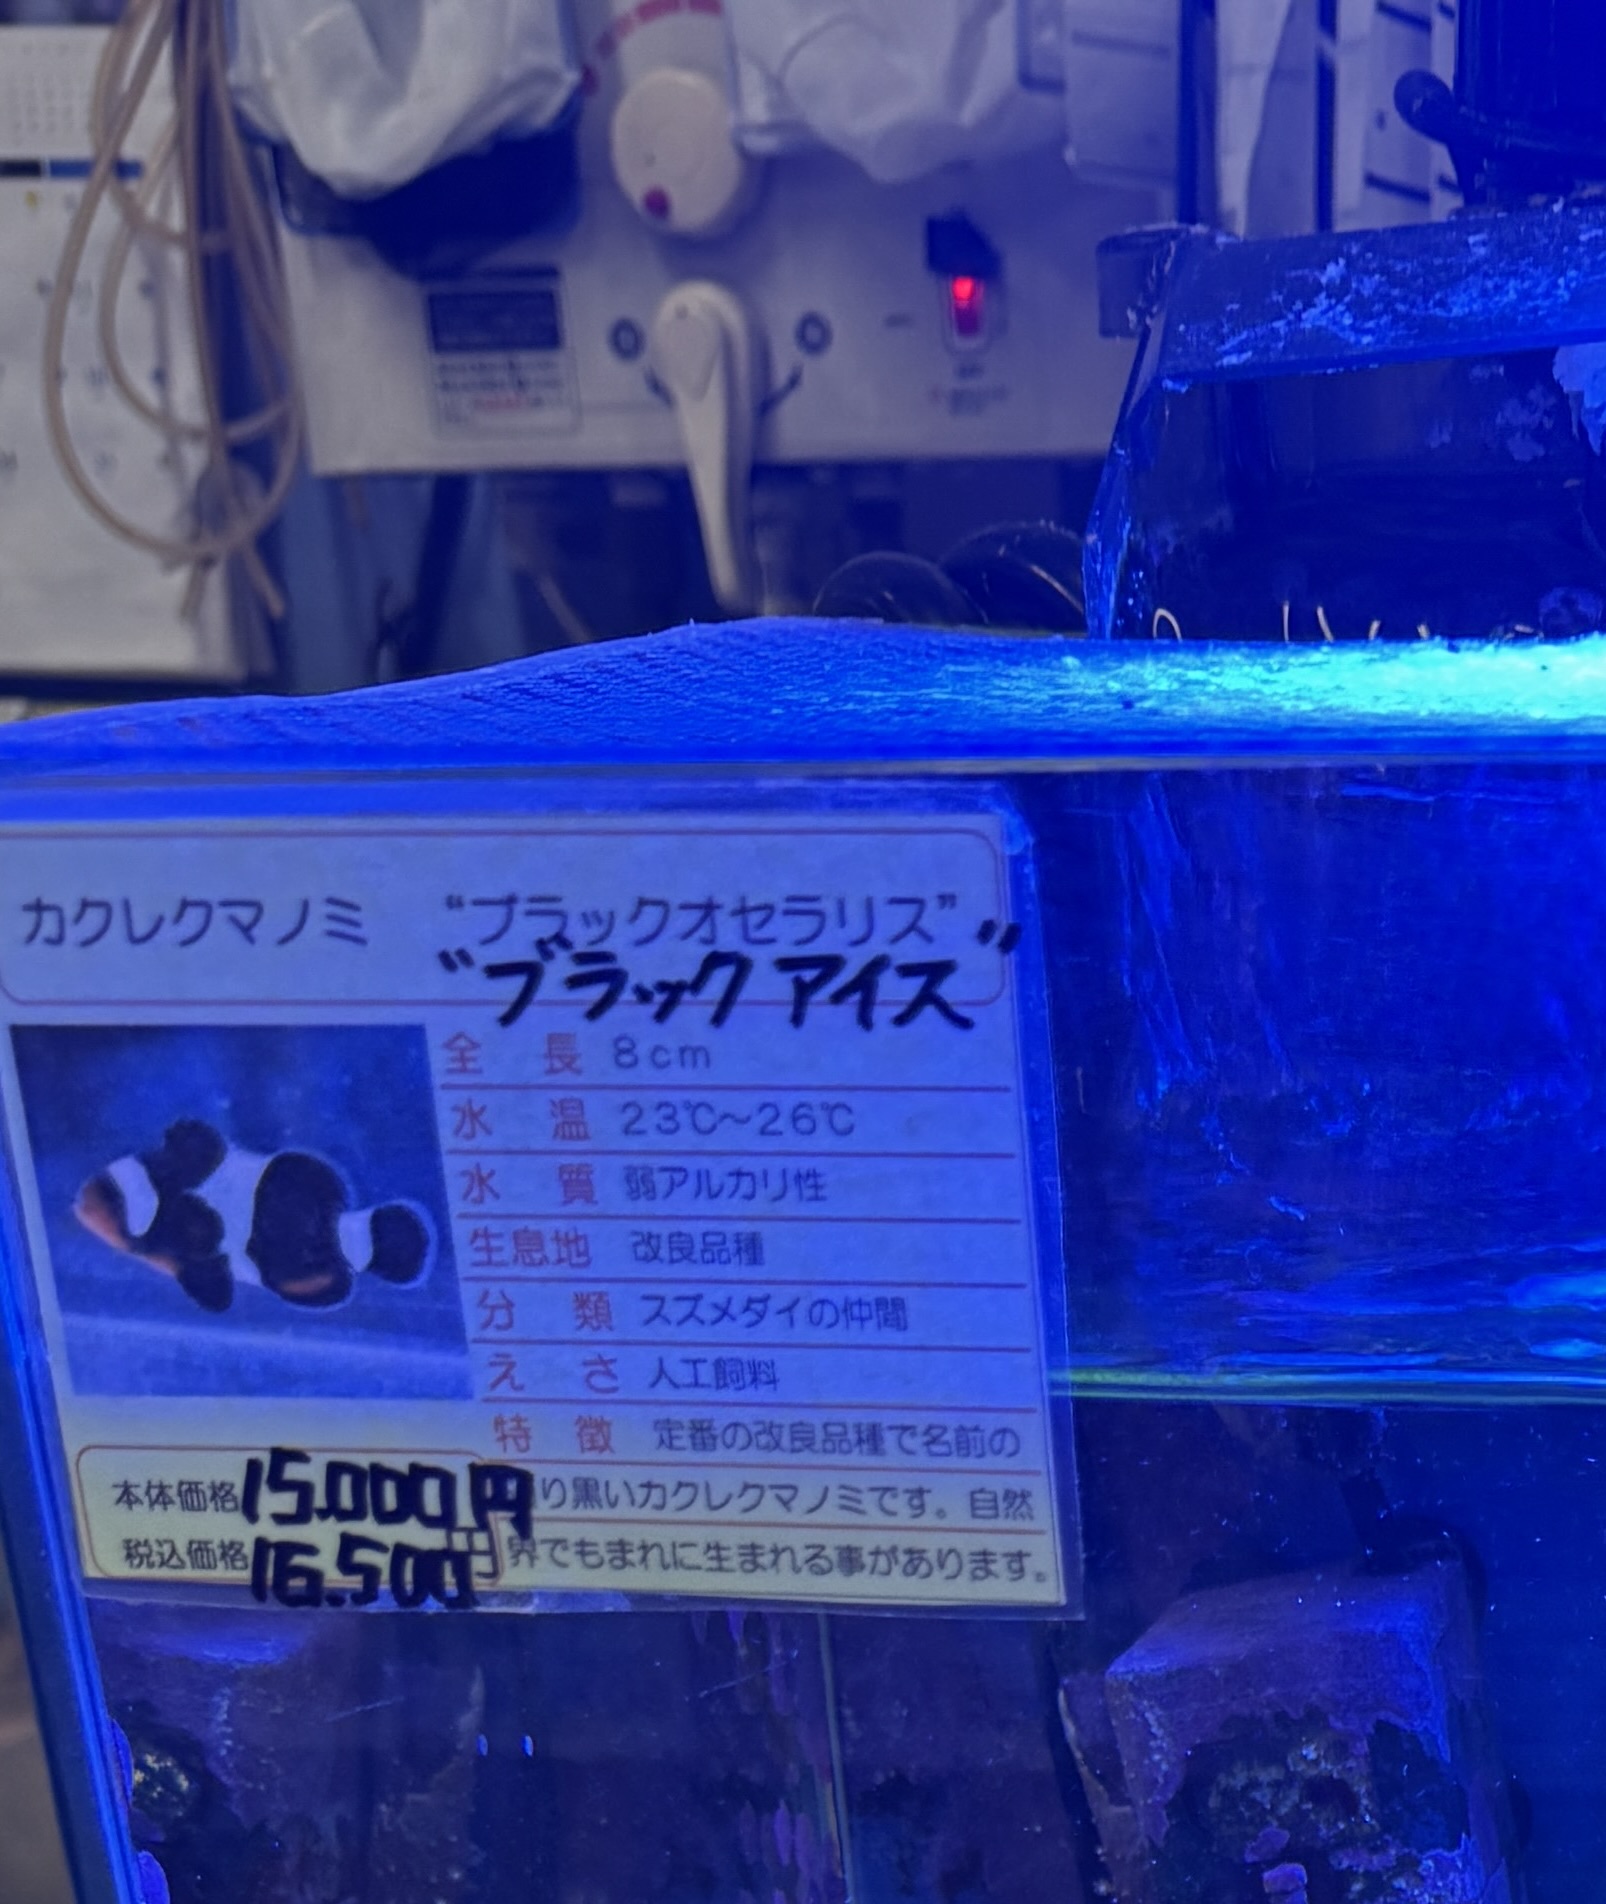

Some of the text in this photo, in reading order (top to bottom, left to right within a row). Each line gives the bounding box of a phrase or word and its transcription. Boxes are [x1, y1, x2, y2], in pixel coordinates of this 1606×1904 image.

[21, 896, 369, 948] カクレクマノミ
[613, 1036, 711, 1071] 8cm
[625, 1166, 827, 1202] 弱アルカリ性
[469, 1227, 764, 1269] 生息地 改良品種
[642, 1293, 908, 1332] スズメダイの仲間
[648, 1358, 779, 1390] 人工飼料
[653, 1418, 1021, 1459] 定番の改良品種で名前の
[113, 1479, 241, 1513] 本体価格
[533, 1476, 1036, 1521] り黒いカクレクマノミです。自然
[122, 1537, 248, 1571] 税込価格
